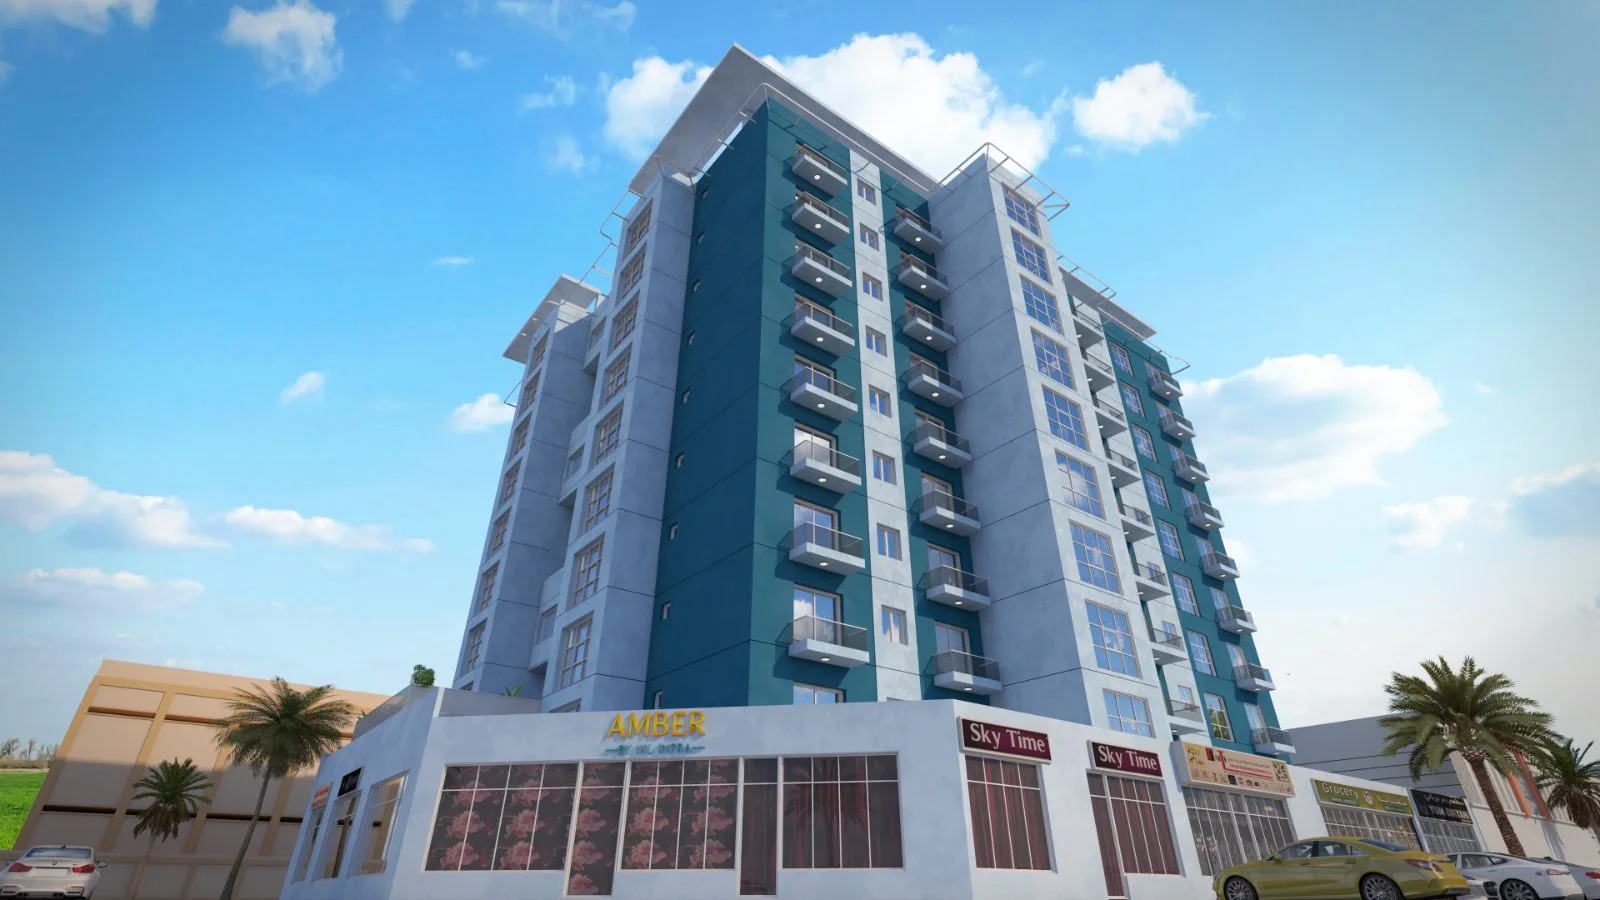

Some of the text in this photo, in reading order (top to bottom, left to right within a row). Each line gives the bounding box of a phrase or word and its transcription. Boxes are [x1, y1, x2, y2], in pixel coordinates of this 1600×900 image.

[607, 710, 706, 738] AMBER
[970, 722, 1046, 753] Sky Time
[1097, 745, 1158, 770] Sky Time
[1321, 782, 1360, 800] Grocery
